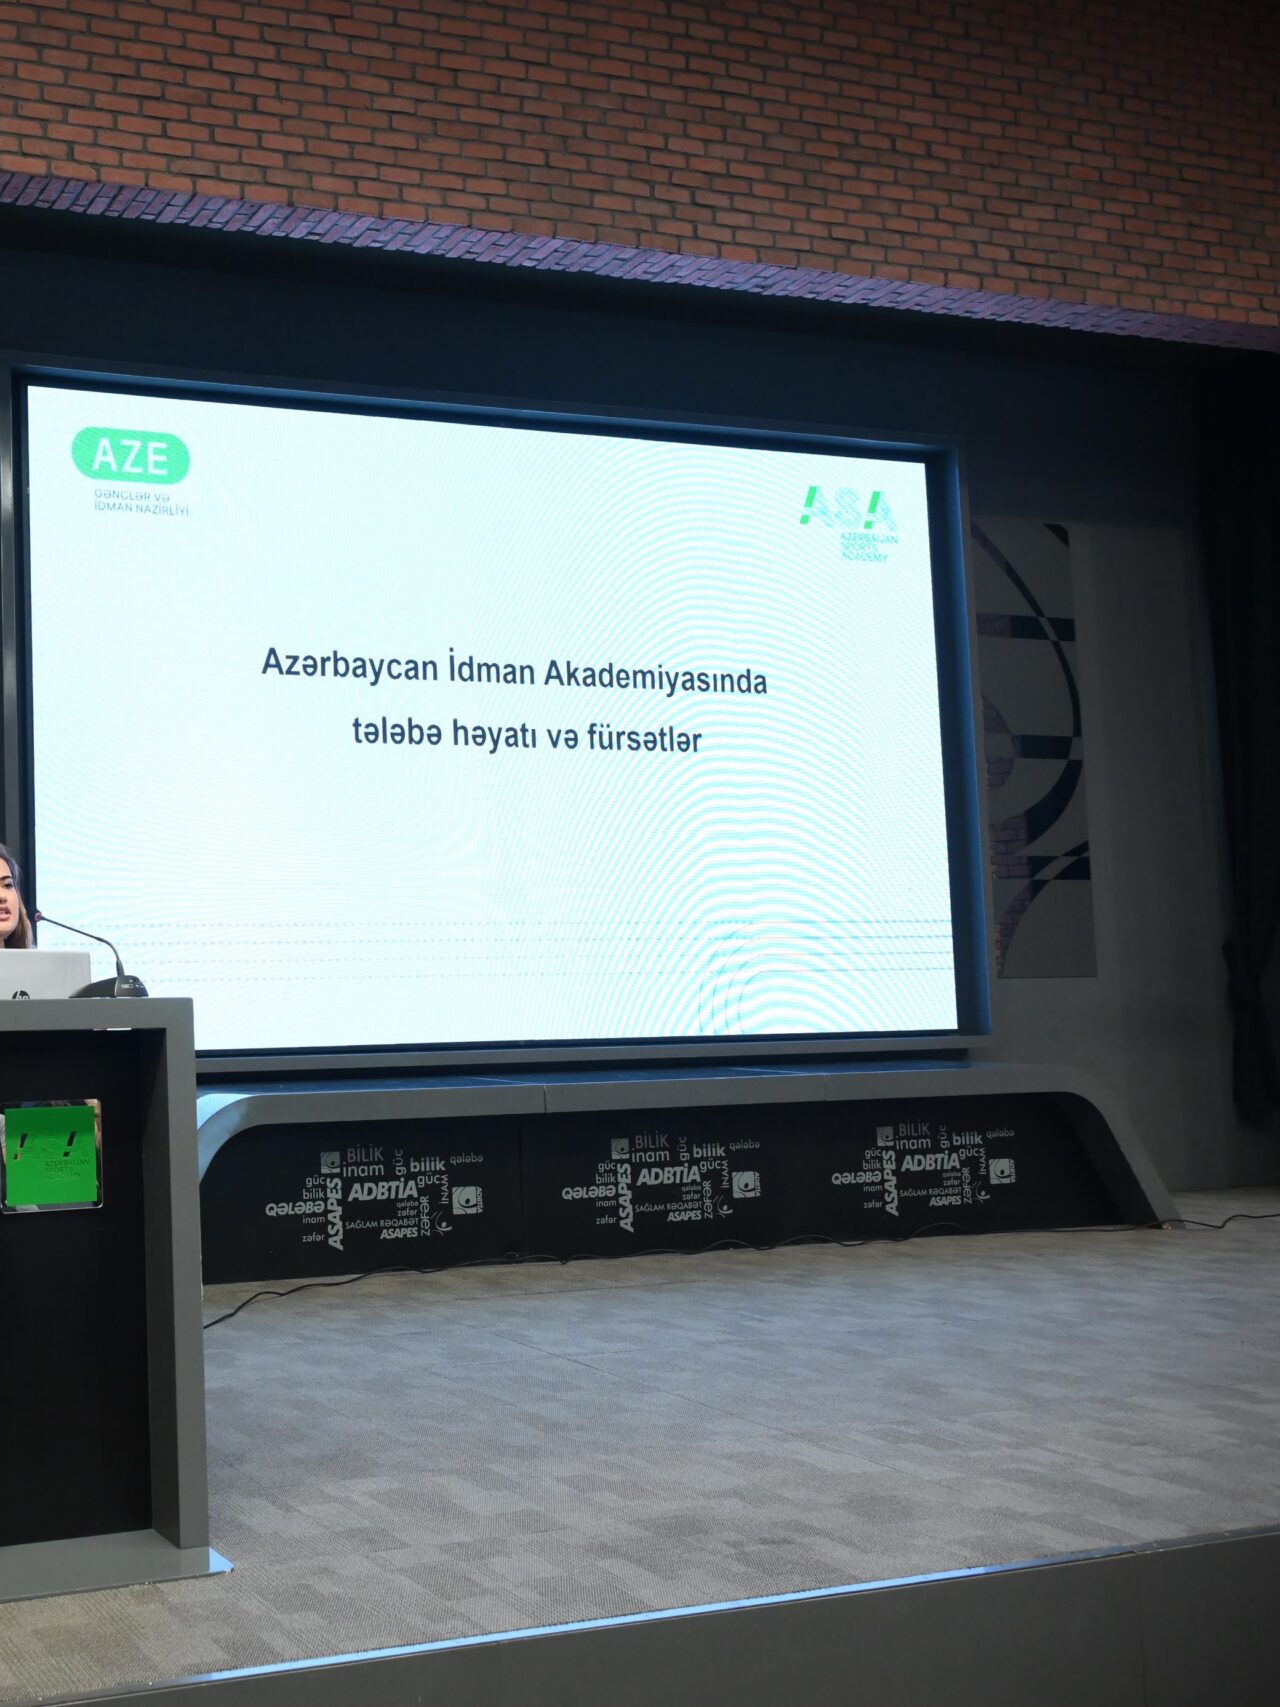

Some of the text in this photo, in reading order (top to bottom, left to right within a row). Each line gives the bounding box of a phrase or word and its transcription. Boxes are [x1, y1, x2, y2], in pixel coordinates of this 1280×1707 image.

[91, 437, 169, 476] AZE
[94, 488, 171, 503] GƏNCLƏR VƏ
[94, 498, 133, 513] İDMAN
[261, 647, 768, 698] Azərbaycan İdman Akademiyasında
[352, 716, 703, 755] tələbə həyatı və fürsətlər
[899, 1120, 931, 1137] BİLİK
[635, 1130, 670, 1149] BİLİK
[729, 1138, 761, 1151] qələbə
[895, 1136, 932, 1150] inam
[952, 1131, 983, 1146] bilik
[347, 1144, 384, 1163] BİLİK
[631, 1147, 670, 1163] inam
[677, 1135, 690, 1161] güc
[692, 1142, 726, 1158] bilik
[864, 1147, 882, 1160] güc
[958, 1145, 980, 1160] güc
[392, 1149, 407, 1176] güc
[410, 1157, 447, 1172] bilik
[449, 1153, 484, 1166] qələbə
[598, 1160, 616, 1173] güc
[700, 1157, 722, 1173] güc
[862, 1159, 882, 1170] bilik
[900, 1149, 961, 1172] ADBTİA
[343, 1161, 385, 1177] inam
[636, 1162, 702, 1186] ADBTİA
[305, 1174, 325, 1188] güc
[417, 1172, 441, 1188] güc
[595, 1172, 616, 1184] bilik
[831, 1170, 882, 1185] QƏLƏBƏ
[882, 1150, 899, 1217] ASAPES
[302, 1188, 325, 1200] bilik
[347, 1177, 419, 1202] ADBTİA
[561, 1184, 617, 1200] QƏLƏBƏ
[863, 1183, 883, 1192] inam
[595, 1198, 617, 1207] inam
[616, 1162, 634, 1233] ASAPES
[863, 1199, 883, 1209] zəfər
[929, 1195, 962, 1207] ASAPES
[265, 1200, 325, 1217] QƏLƏBƏ
[326, 1177, 344, 1251] ASAPES
[397, 1208, 418, 1217] zəfər
[634, 1202, 665, 1213] SAĞLAM
[302, 1214, 325, 1224] inam
[595, 1214, 617, 1225] zəfər
[666, 1209, 702, 1222] ASAPES
[345, 1217, 419, 1230] SAĞLAM RƏQABƏT
[302, 1231, 325, 1243] zəfər
[380, 1227, 419, 1240] ASAPES
